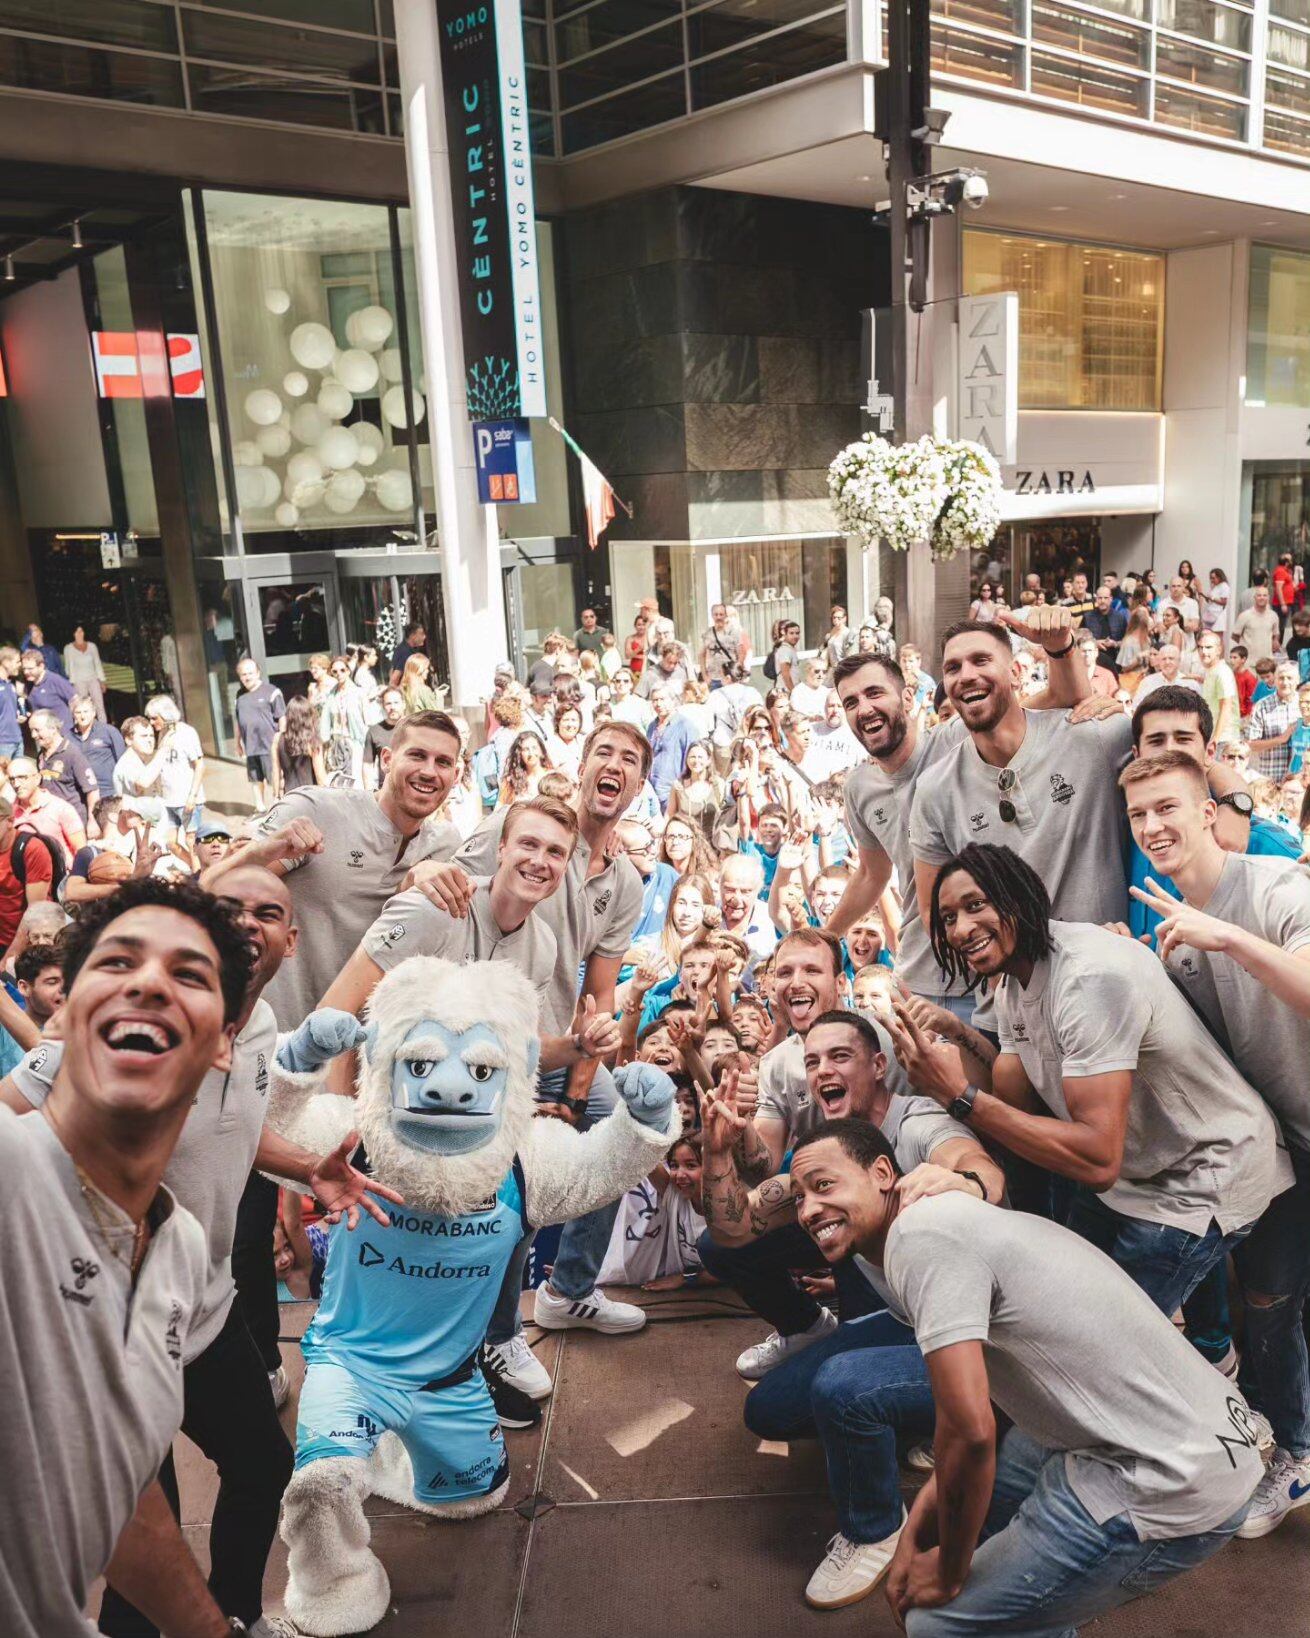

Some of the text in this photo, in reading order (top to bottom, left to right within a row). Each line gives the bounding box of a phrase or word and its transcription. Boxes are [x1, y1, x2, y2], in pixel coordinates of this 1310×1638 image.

[446, 7, 488, 37] YOMO
[516, 202, 530, 268] YOMO
[522, 295, 538, 383] HOTEL
[964, 301, 1004, 458] ZARA
[477, 428, 493, 469] P
[1015, 470, 1096, 496] ZARA
[732, 585, 795, 606] ZARA
[388, 1211, 502, 1237] MORABANC
[388, 1255, 491, 1279] Andorra
